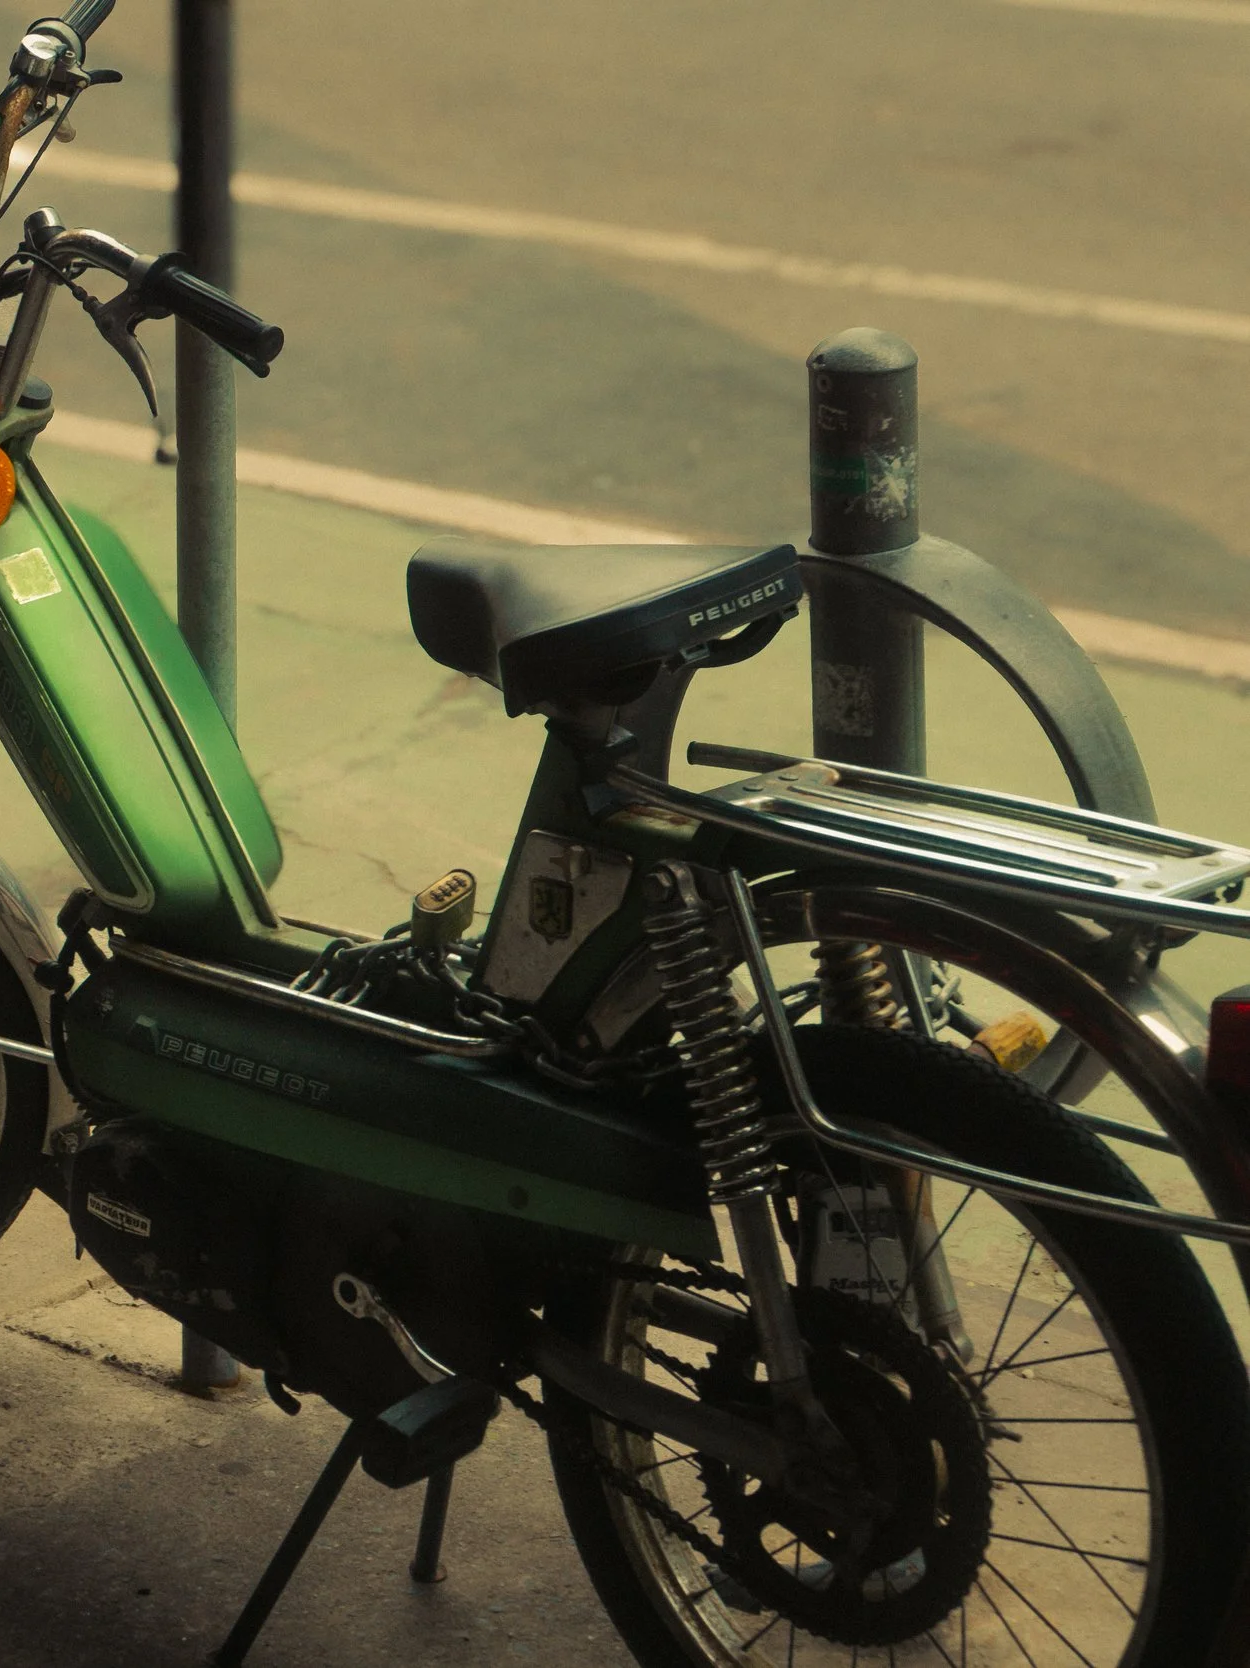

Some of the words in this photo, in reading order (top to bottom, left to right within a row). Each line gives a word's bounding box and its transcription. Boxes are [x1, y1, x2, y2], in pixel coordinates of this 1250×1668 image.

[688, 578, 787, 627] PEUGEOT
[159, 1034, 331, 1101] PEUGEOT
[89, 1198, 149, 1231] VARIATEUR
